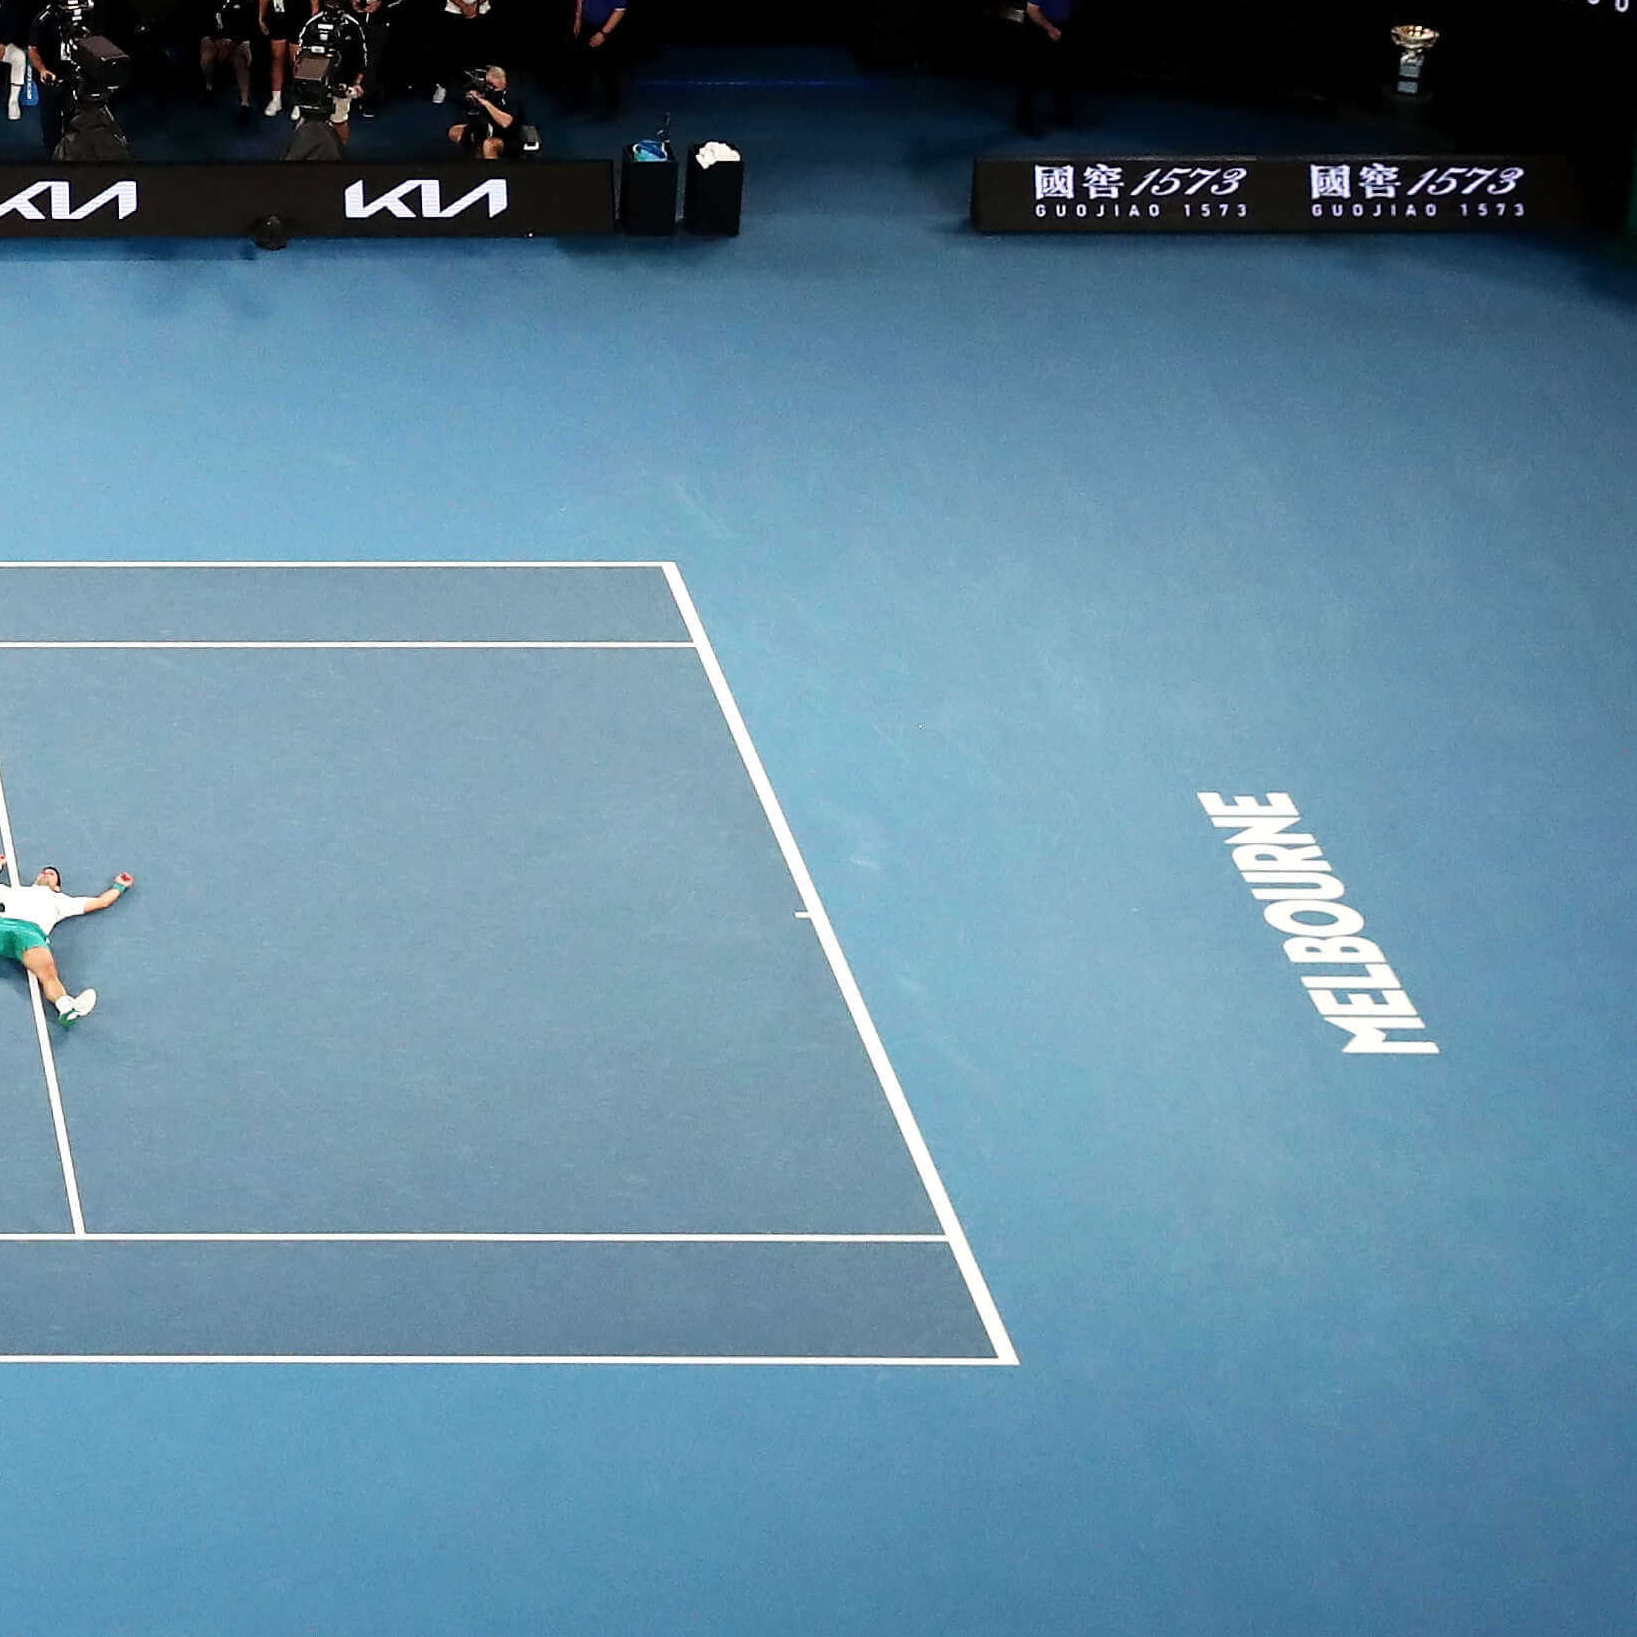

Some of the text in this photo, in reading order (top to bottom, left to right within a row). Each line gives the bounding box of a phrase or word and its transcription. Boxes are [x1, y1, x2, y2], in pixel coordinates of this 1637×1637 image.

[345, 179, 508, 218] KIA
[1035, 204, 1247, 218] GUOJIAO 1573
[1311, 203, 1525, 217] GUOJIAO 1573
[1196, 791, 1440, 1054] MELBOURNE
